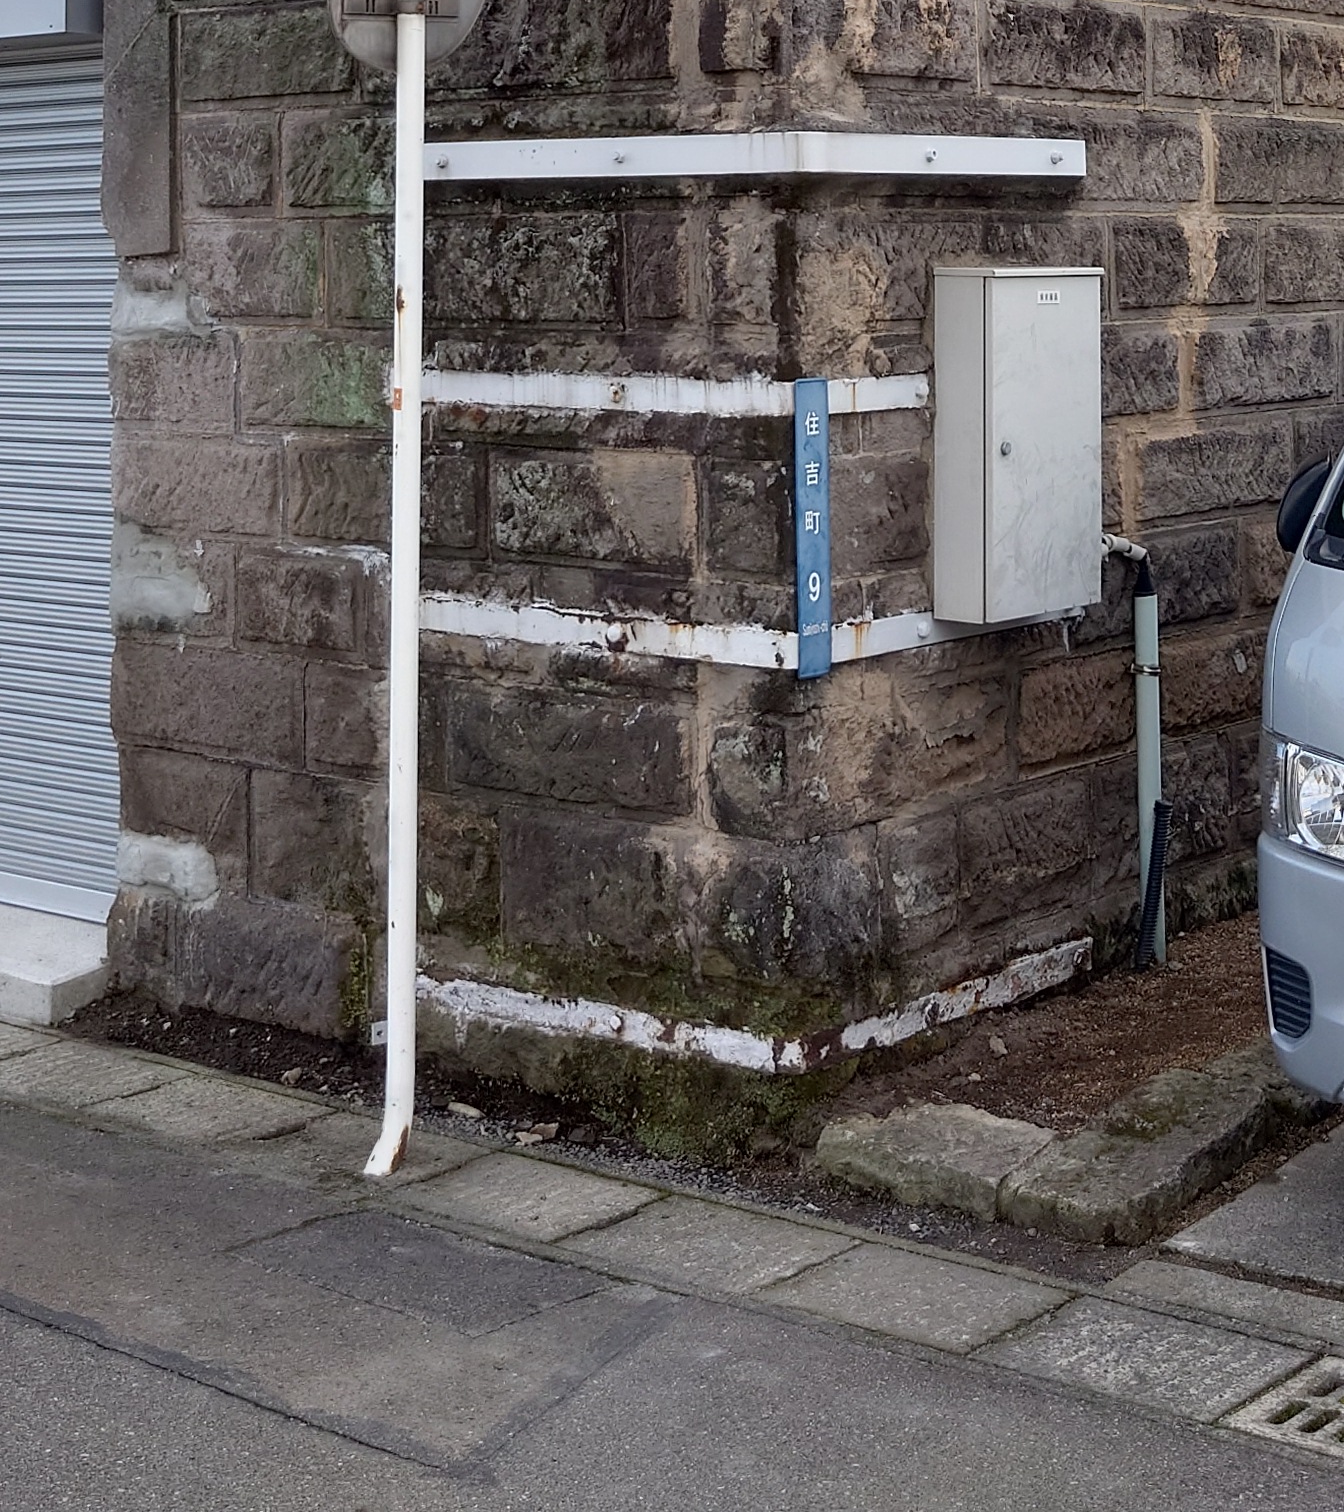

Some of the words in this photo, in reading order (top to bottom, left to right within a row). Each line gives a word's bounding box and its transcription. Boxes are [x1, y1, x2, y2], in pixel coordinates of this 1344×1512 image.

[804, 411, 820, 535] 住吉町
[808, 572, 820, 602] 9
